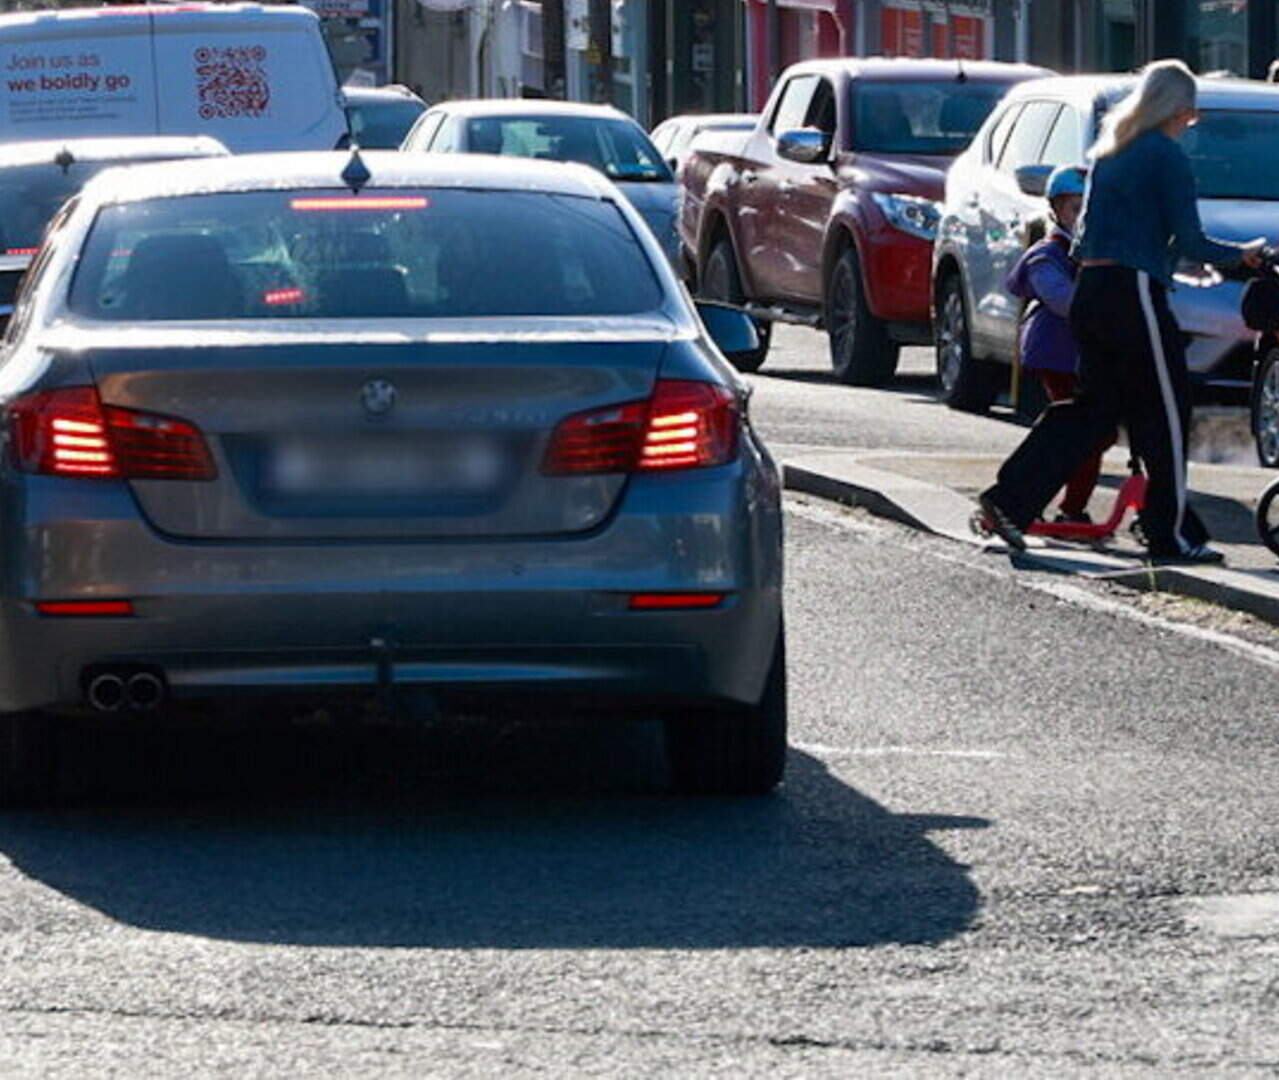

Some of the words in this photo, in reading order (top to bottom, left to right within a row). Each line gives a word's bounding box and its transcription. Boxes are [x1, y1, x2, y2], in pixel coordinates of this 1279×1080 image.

[6, 52, 45, 71] Join
[49, 55, 73, 69] us
[77, 54, 100, 67] as
[7, 79, 36, 93] we
[40, 72, 100, 92] boldly
[105, 74, 131, 92] go
